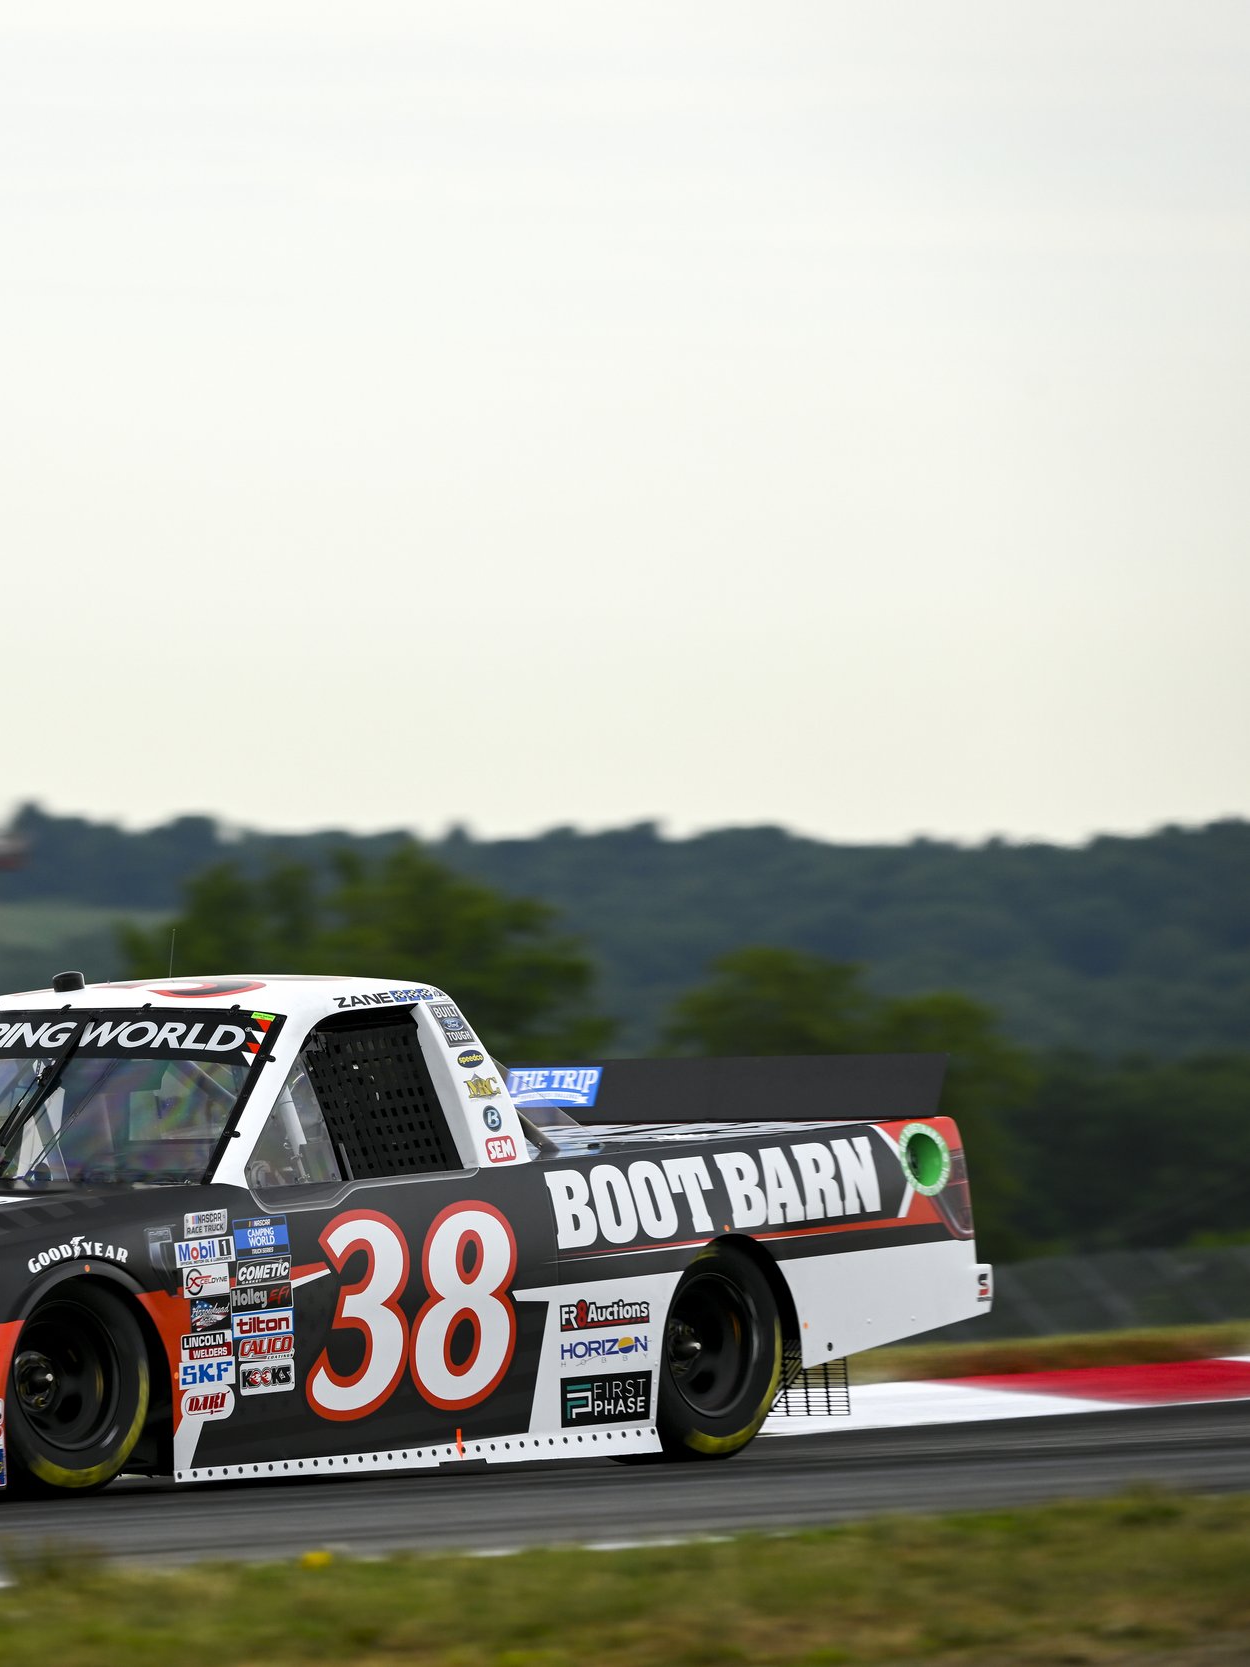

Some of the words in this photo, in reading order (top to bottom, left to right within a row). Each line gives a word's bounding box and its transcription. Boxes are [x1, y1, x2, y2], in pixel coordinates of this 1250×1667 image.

[333, 992, 394, 1008] ZANE
[432, 1006, 459, 1018] BUILT
[79, 1021, 246, 1051] WORLD
[446, 1031, 472, 1041] TOUGH
[510, 1071, 550, 1094] THE
[551, 1070, 599, 1093] TRIP
[487, 1139, 515, 1159] SEM
[544, 1156, 714, 1249] BOOT
[713, 1136, 881, 1228] BARN
[197, 1212, 222, 1224] NASCAR
[186, 1226, 203, 1235] RACE
[204, 1223, 224, 1232] TRUCK
[247, 1227, 275, 1238] CAMPING
[178, 1240, 215, 1261] Mobil
[221, 1240, 228, 1256] 1
[248, 1235, 275, 1247] WORLD
[28, 1241, 129, 1273] GOODYEAR
[238, 1261, 290, 1282] COMETIC
[232, 1288, 268, 1308] Holley
[306, 1200, 517, 1421] 38
[237, 1317, 289, 1334] tilton
[184, 1333, 223, 1348] LINCOLN
[240, 1335, 293, 1356] CALICO
[561, 1335, 648, 1360] HORIZON
[193, 1347, 227, 1359] WELDERS
[182, 1361, 233, 1385] SKF
[241, 1365, 291, 1388] KOOKS
[593, 1379, 647, 1399] FIRST
[594, 1397, 646, 1416] PHASE
